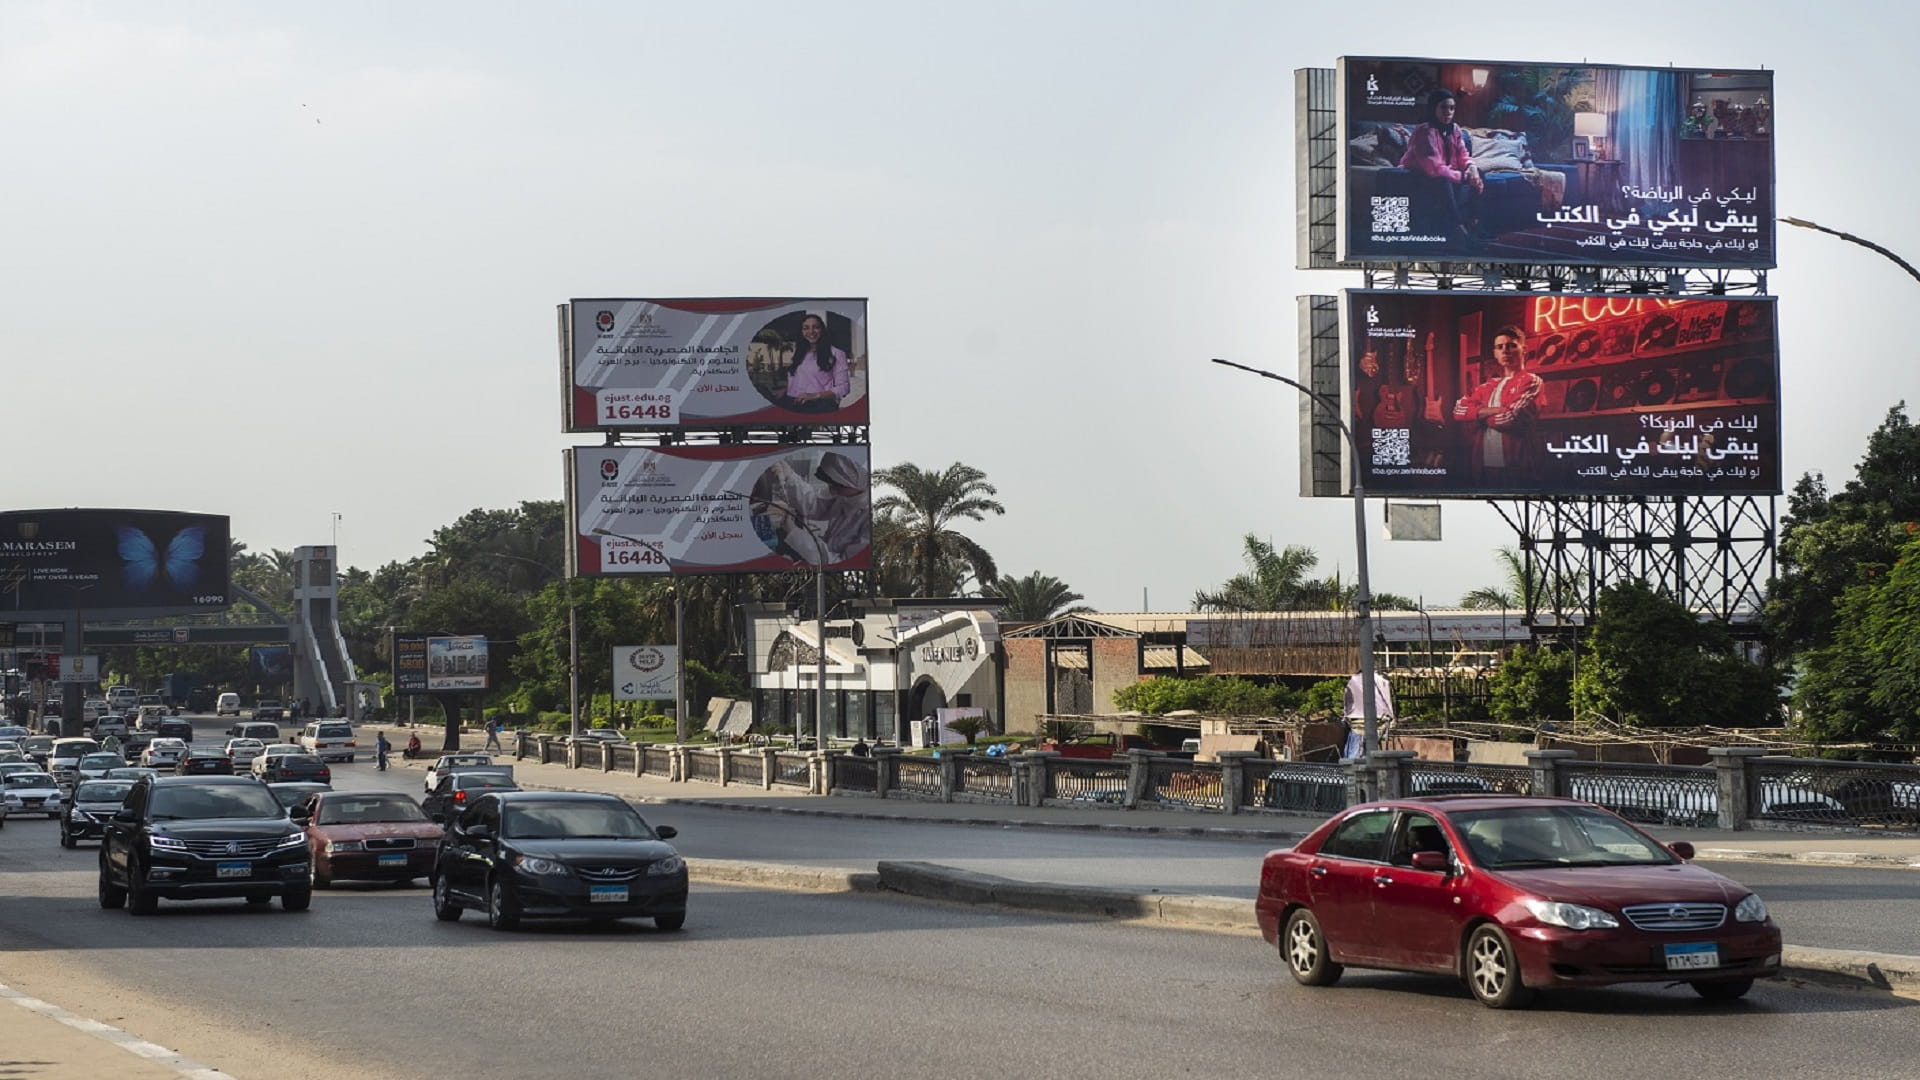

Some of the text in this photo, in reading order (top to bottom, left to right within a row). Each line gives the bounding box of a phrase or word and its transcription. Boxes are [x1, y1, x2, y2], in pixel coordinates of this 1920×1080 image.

[1537, 205, 1757, 235] يبقى ليكي في الكتب
[1577, 236, 1605, 247] الكتب
[1610, 238, 1626, 250] في
[1679, 239, 1702, 249] حاجة
[1706, 240, 1722, 253] في
[1748, 240, 1758, 251] لو
[604, 393, 672, 403] ejust.edu.eg
[605, 405, 671, 419] 16448
[1640, 414, 1757, 436] ليك في المزيكا؟
[1547, 434, 1760, 464] يبقى ليك في الكتب
[1578, 466, 1607, 476] الكتب
[1611, 468, 1626, 480] في
[1630, 466, 1649, 477] ليك
[1680, 467, 1703, 475] حاجة
[1707, 468, 1723, 480] في
[1727, 467, 1746, 477] ليك
[1750, 467, 1759, 479] لو
[608, 551, 663, 564] 16448
[192, 595, 224, 604] 16090
